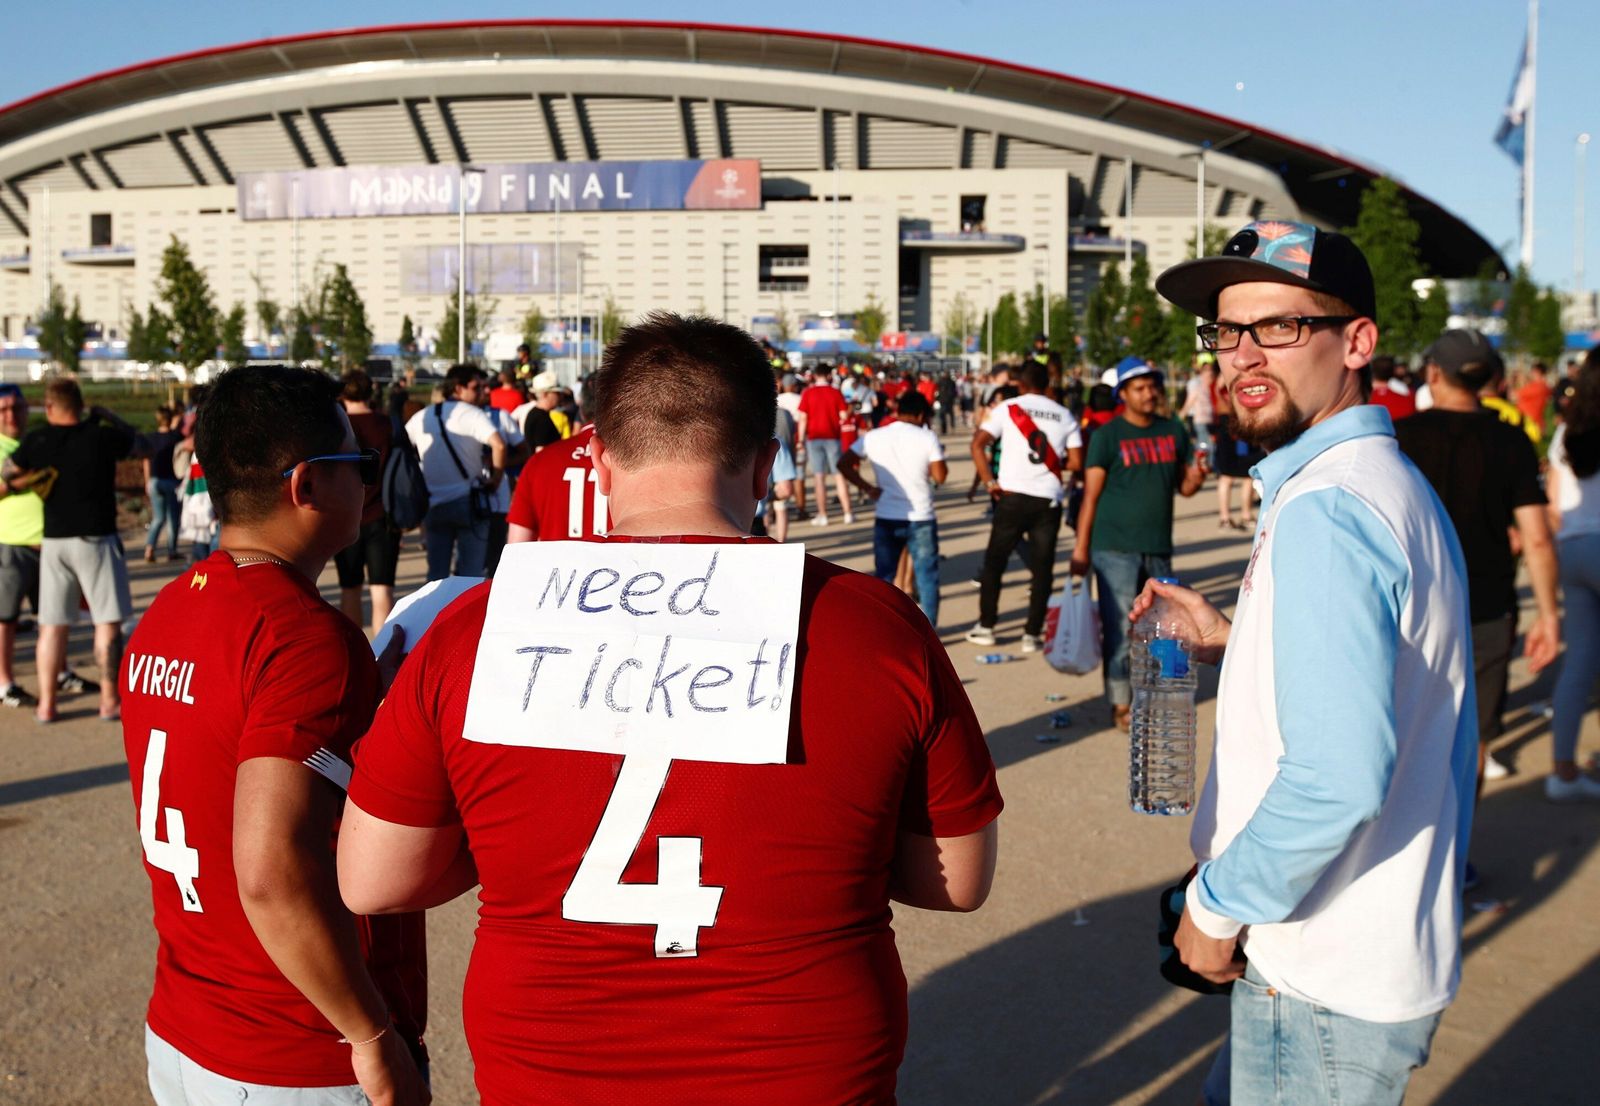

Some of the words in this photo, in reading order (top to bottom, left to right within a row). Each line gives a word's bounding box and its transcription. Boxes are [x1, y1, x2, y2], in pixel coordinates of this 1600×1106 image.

[502, 172, 632, 201] FINAL
[1028, 430, 1048, 464] 9
[562, 467, 608, 538] 11
[536, 549, 720, 616] Need
[128, 653, 195, 705] VIRGIL
[516, 634, 791, 718] Ticket!
[140, 728, 204, 913] 4
[561, 755, 726, 958] 4
